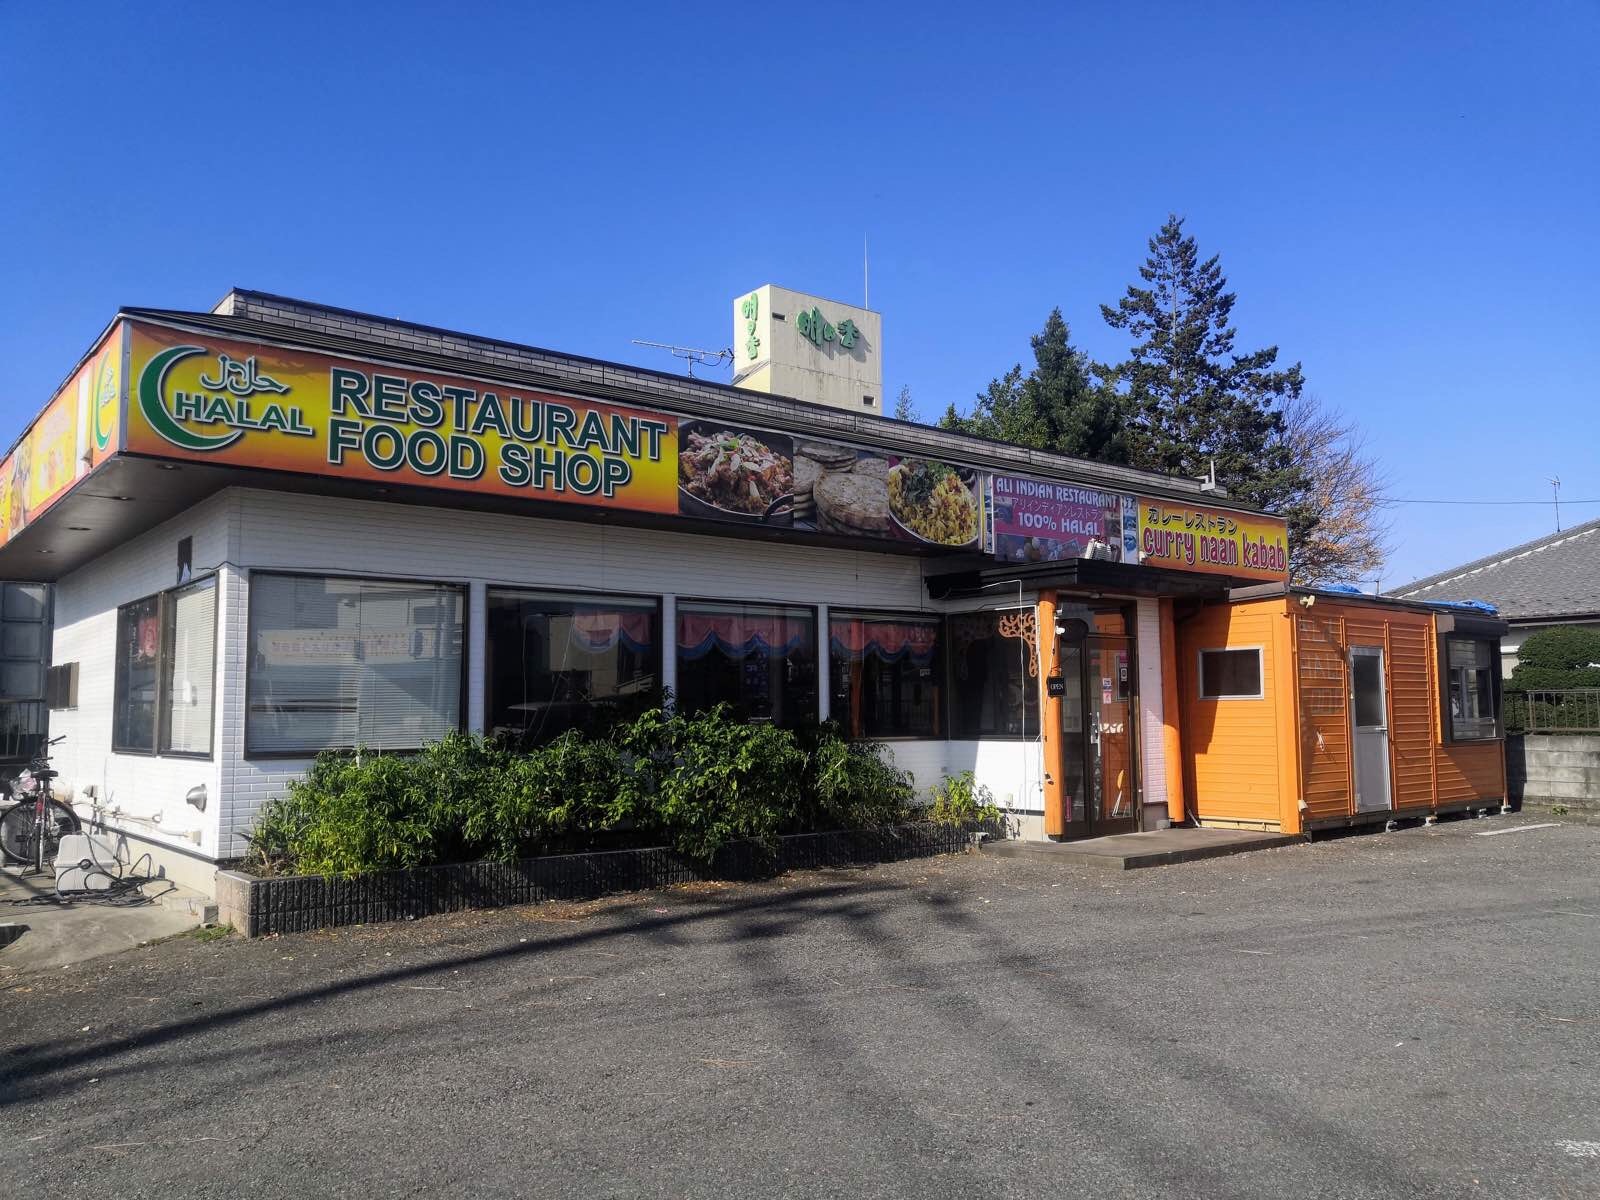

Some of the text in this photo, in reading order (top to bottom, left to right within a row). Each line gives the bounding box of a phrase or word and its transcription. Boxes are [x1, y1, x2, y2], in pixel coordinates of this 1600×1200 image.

[200, 353, 291, 395] حلال
[174, 392, 313, 436] HALAL
[330, 366, 667, 460] RESTAURANT
[327, 417, 631, 497] FOOD SHOP
[996, 477, 1117, 509] ALI INDIAN RESTAURANT
[1018, 511, 1101, 536] 100% HALAL
[1147, 506, 1237, 535] カレーレストラン
[1143, 527, 1287, 571] curry naan kabab
[1050, 683, 1064, 691] OPEN
